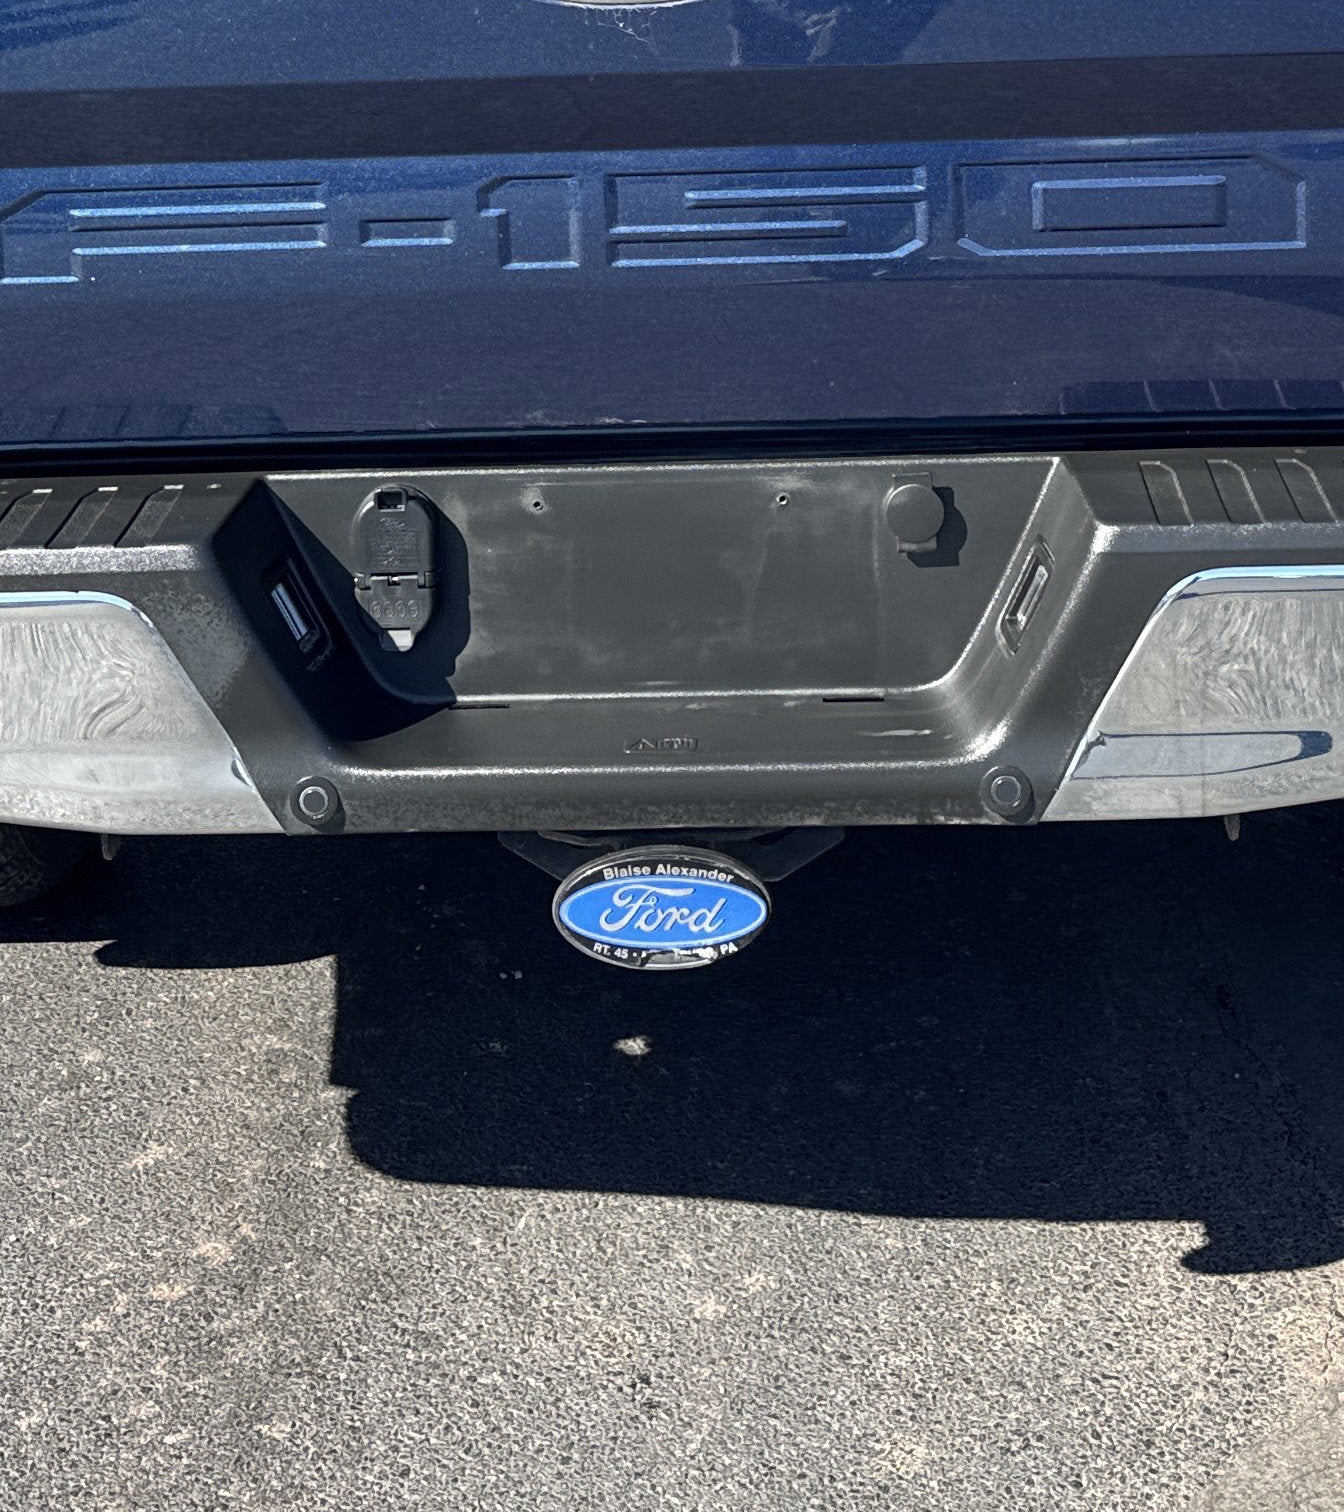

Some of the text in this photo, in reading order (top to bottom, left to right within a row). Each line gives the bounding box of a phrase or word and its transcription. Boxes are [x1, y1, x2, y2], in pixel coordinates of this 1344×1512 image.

[602, 863, 735, 883] Blaise Alexander
[599, 884, 728, 934] Ford
[613, 946, 629, 959] 45
[719, 941, 739, 955] PA
